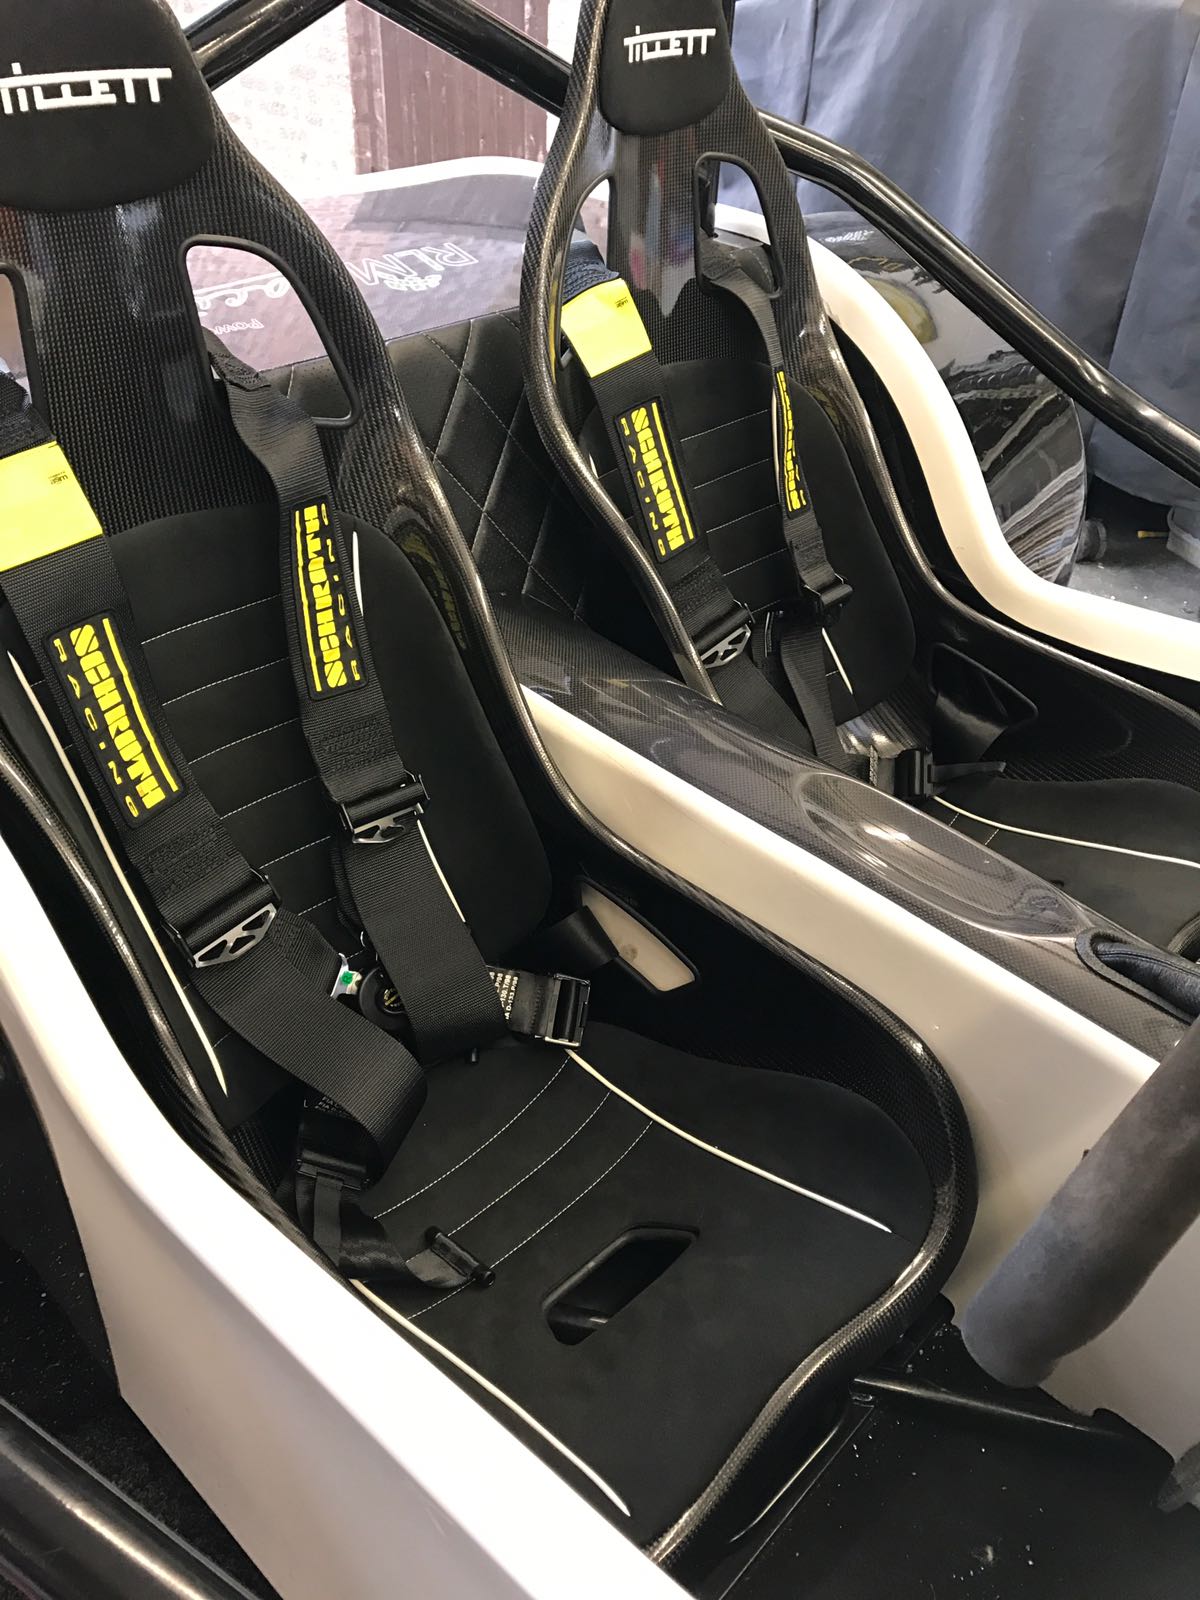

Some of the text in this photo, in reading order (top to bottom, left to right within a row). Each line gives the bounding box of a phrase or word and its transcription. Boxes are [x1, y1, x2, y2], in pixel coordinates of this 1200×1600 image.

[620, 417, 666, 557] RACING
[631, 407, 686, 551] SCHROTH
[303, 504, 348, 688] SCHROTH
[320, 503, 361, 681] RACING
[53, 638, 139, 818] RACING
[69, 624, 166, 810] SCHROTH
